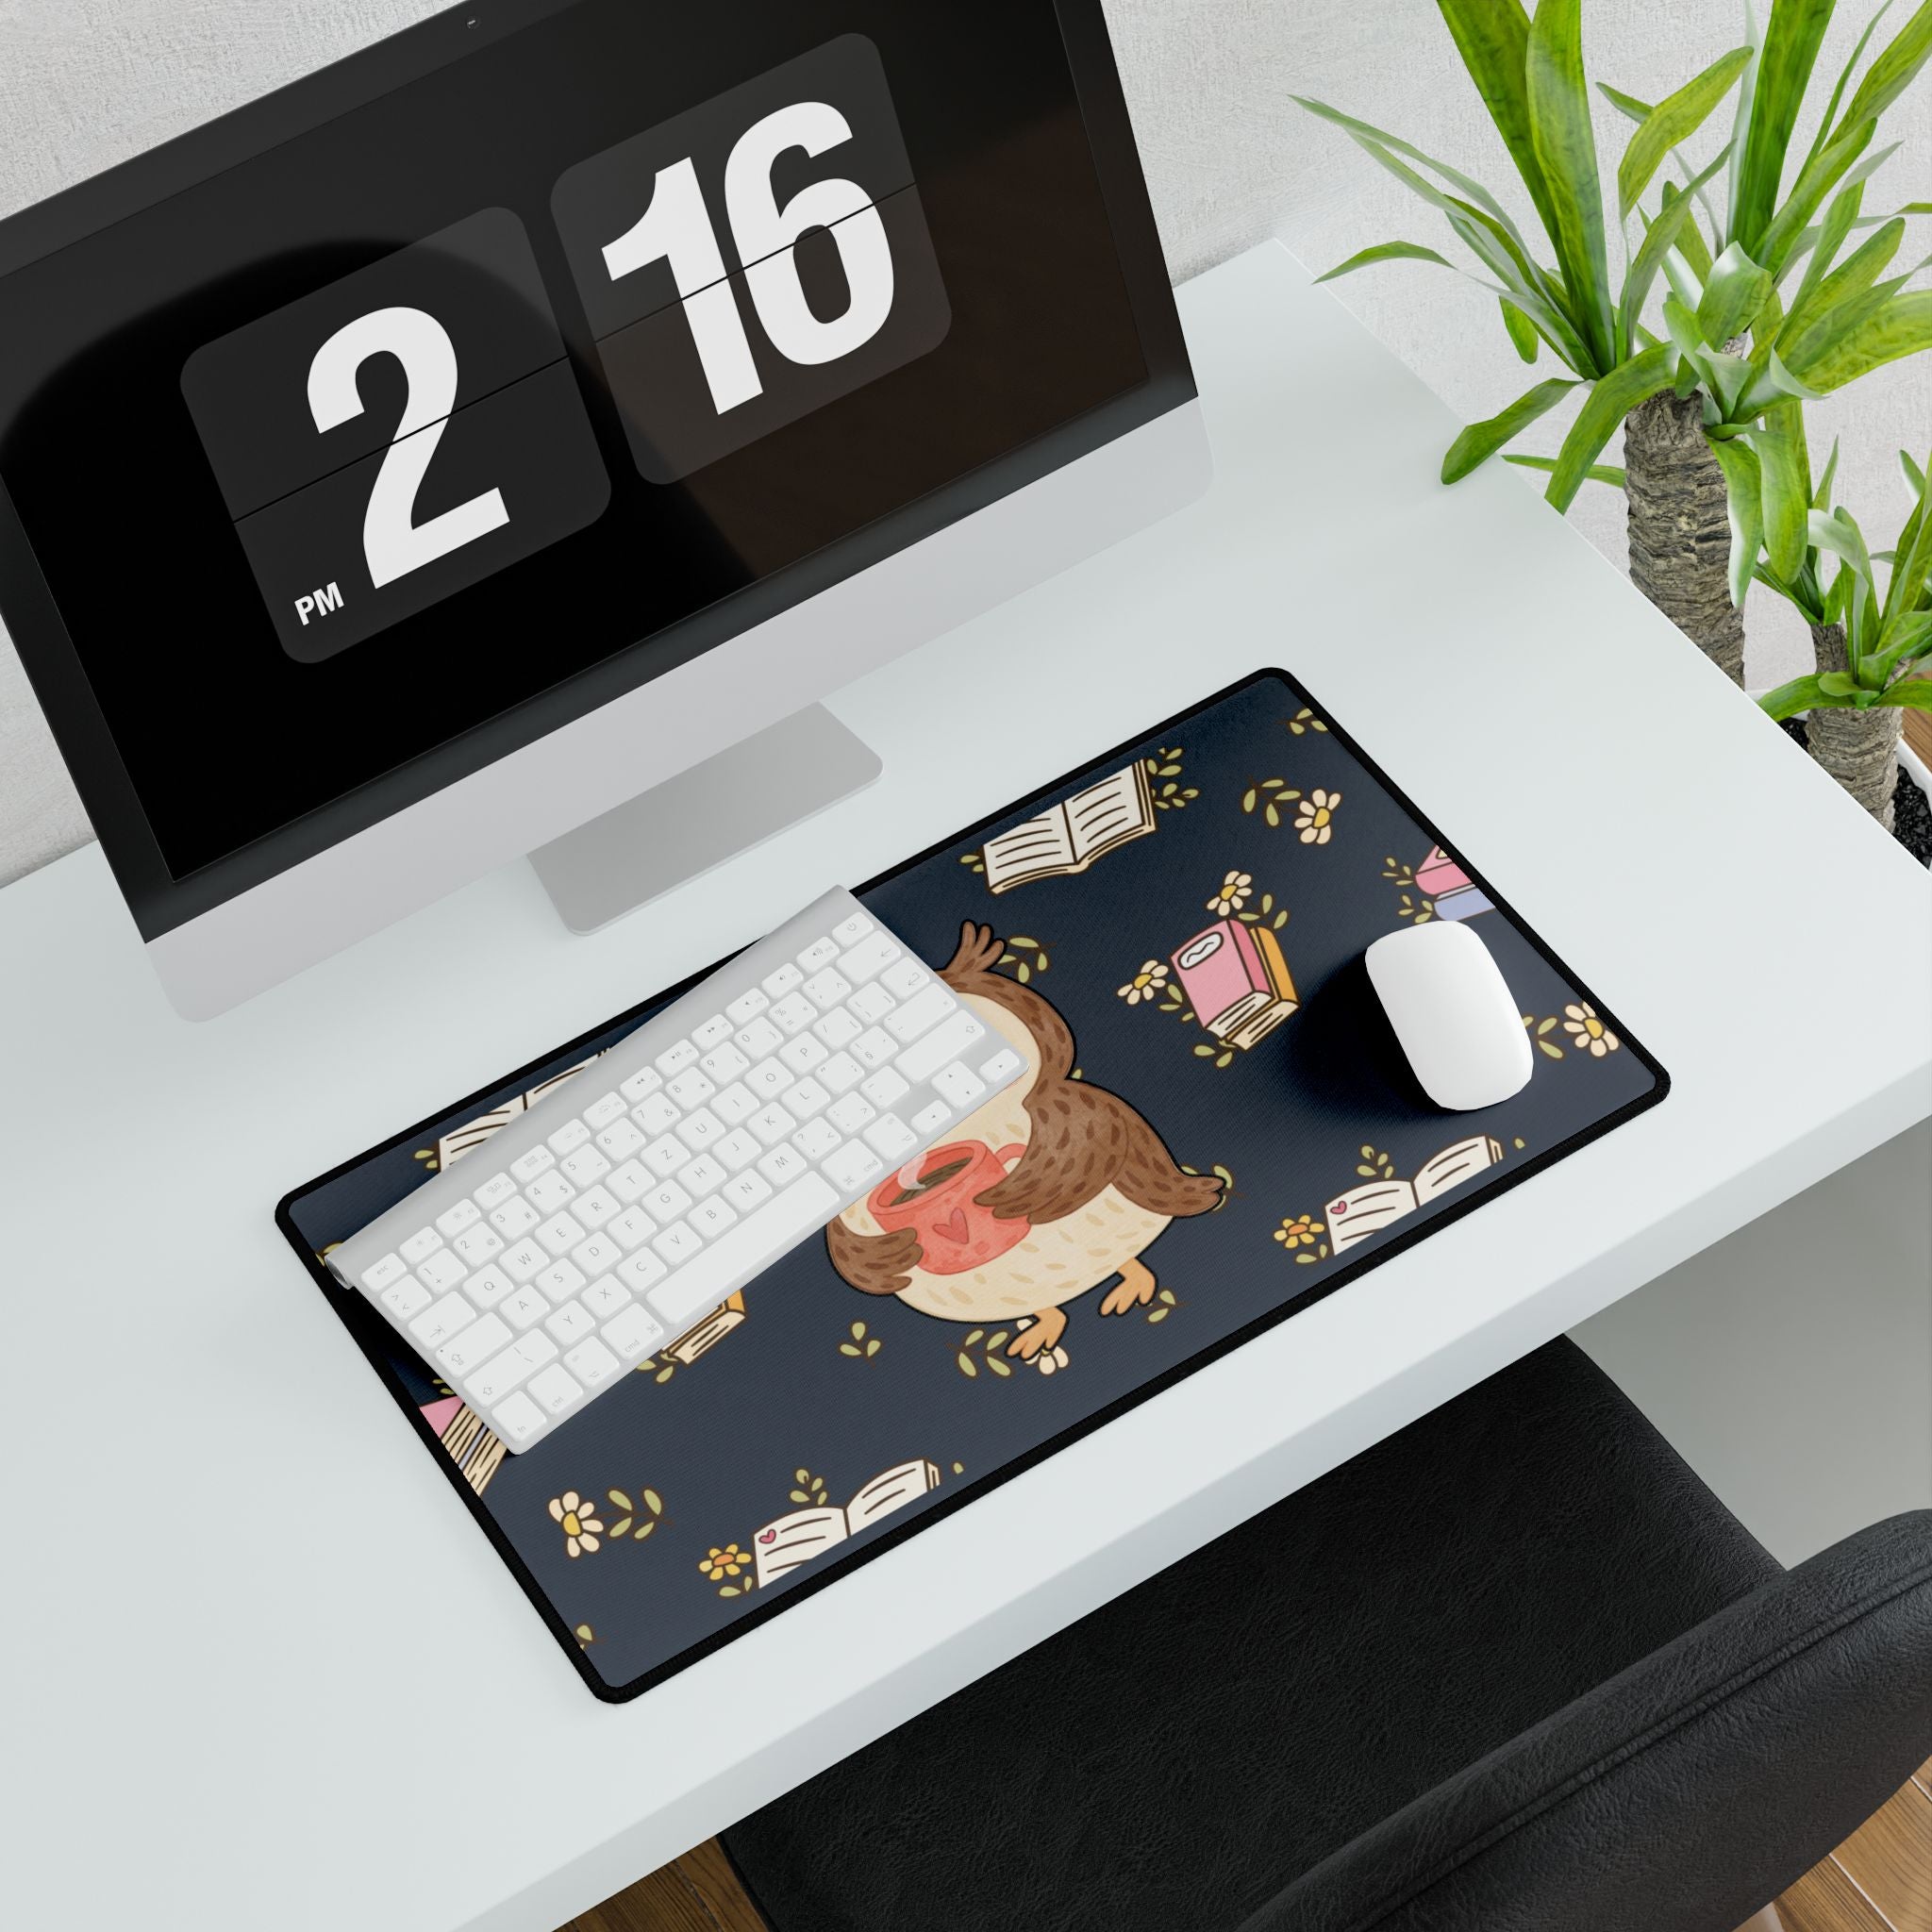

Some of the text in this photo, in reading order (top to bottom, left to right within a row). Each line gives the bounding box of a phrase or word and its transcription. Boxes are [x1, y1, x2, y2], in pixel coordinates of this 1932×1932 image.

[308, 102, 893, 589] 2 16
[294, 582, 343, 625] PM
[741, 1034, 751, 1042] 0
[799, 1047, 808, 1058] P
[706, 1058, 715, 1069] 9
[765, 1072, 777, 1083] O
[672, 1084, 682, 1093] 8
[798, 1091, 810, 1101] L
[636, 1108, 646, 1120] 7
[763, 1115, 776, 1126] K
[694, 1122, 708, 1134] U
[603, 1136, 612, 1145] 6
[731, 1141, 741, 1152] J
[660, 1148, 673, 1161] Z
[566, 1160, 577, 1172] 5
[774, 1156, 790, 1169] M
[693, 1166, 708, 1178] H
[625, 1174, 637, 1185] T
[533, 1187, 542, 1196] 4
[740, 1181, 754, 1194] N
[659, 1192, 672, 1205] G
[591, 1201, 603, 1212] R
[495, 1213, 507, 1224] 3
[705, 1209, 717, 1221] B
[624, 1219, 634, 1230] F
[555, 1227, 567, 1239] E
[459, 1240, 471, 1250] 2
[669, 1234, 681, 1245] V
[588, 1246, 600, 1257] D
[517, 1252, 532, 1266] W
[635, 1260, 647, 1273] C
[553, 1273, 564, 1284] S
[483, 1281, 496, 1291] Q
[598, 1288, 612, 1300] X
[518, 1300, 529, 1311] A
[562, 1314, 574, 1325] Y
